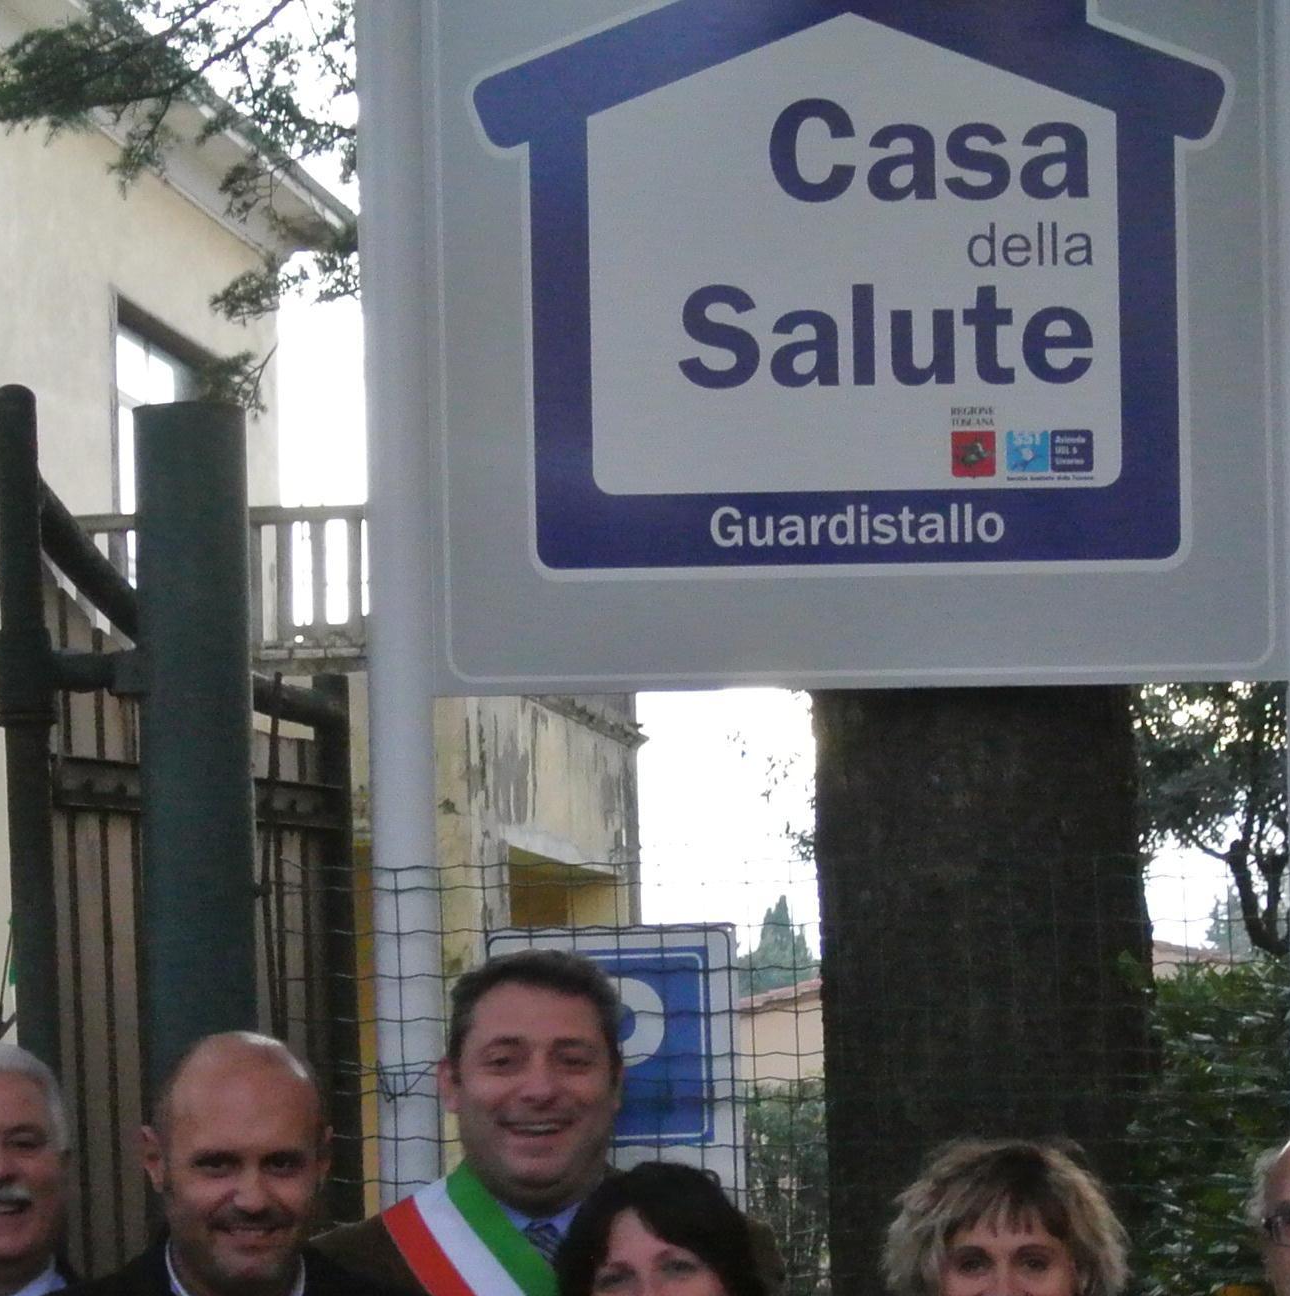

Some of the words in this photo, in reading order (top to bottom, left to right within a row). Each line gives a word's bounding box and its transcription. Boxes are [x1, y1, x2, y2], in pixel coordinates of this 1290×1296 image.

[769, 97, 1091, 202] Casa
[966, 222, 1095, 268] della
[678, 283, 1095, 390] Salute
[710, 504, 1005, 548] Guardistallo
